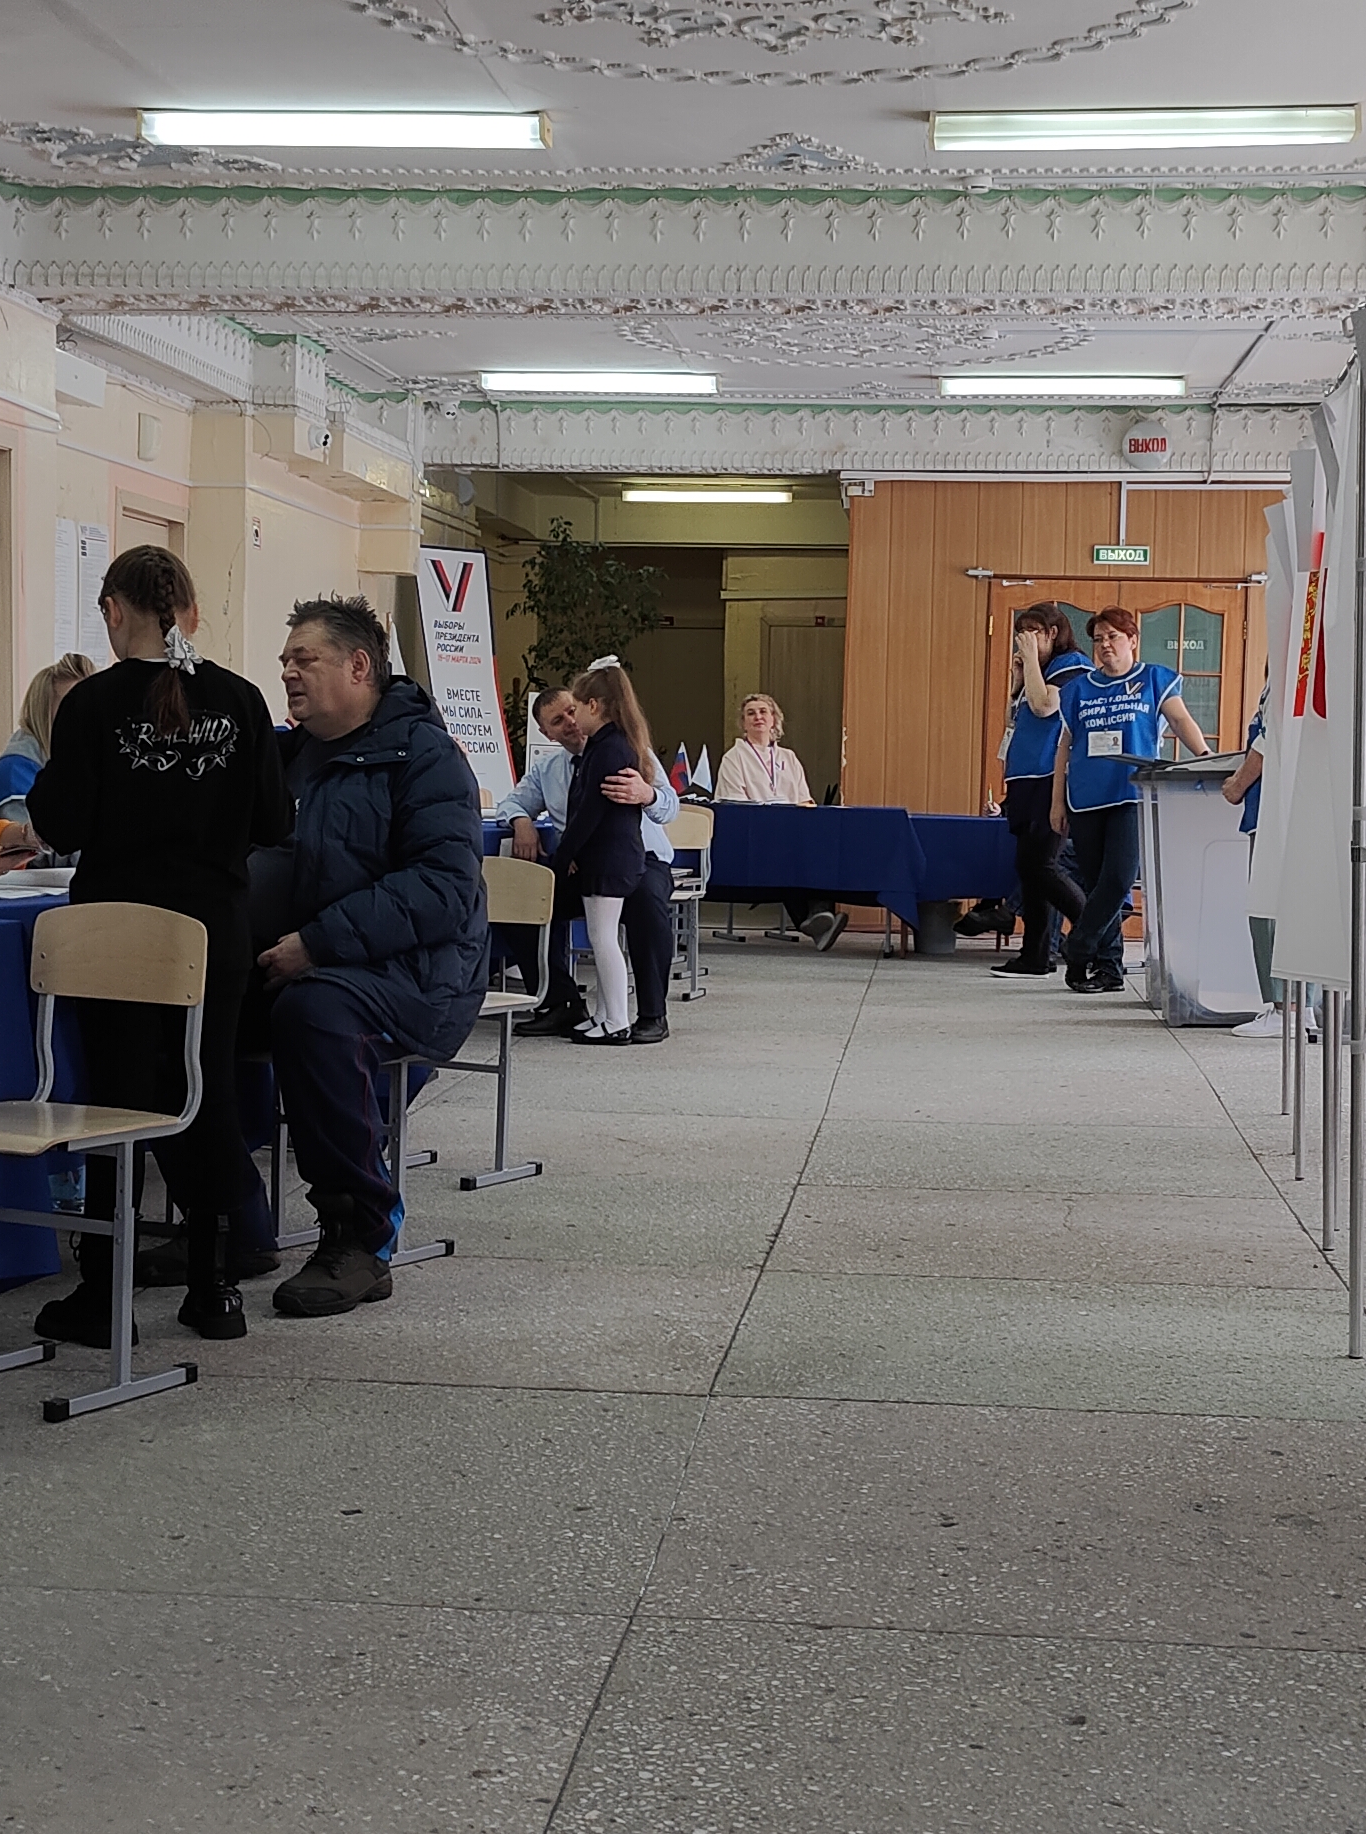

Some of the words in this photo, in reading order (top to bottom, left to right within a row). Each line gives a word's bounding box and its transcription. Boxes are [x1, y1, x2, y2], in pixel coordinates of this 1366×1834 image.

[1128, 438, 1166, 453] ВЫХОД
[1098, 549, 1145, 562] ВЫХОД
[434, 620, 465, 630] ВЫБОРЫ
[435, 631, 480, 643] ПРЕЗИДЕНТА
[436, 643, 464, 653] РОССИИ
[446, 688, 481, 702] ВМЕСТЕ
[441, 704, 457, 717] МЫ
[458, 706, 483, 719] СИЛА
[446, 722, 493, 736] ОЛОСУЕМ
